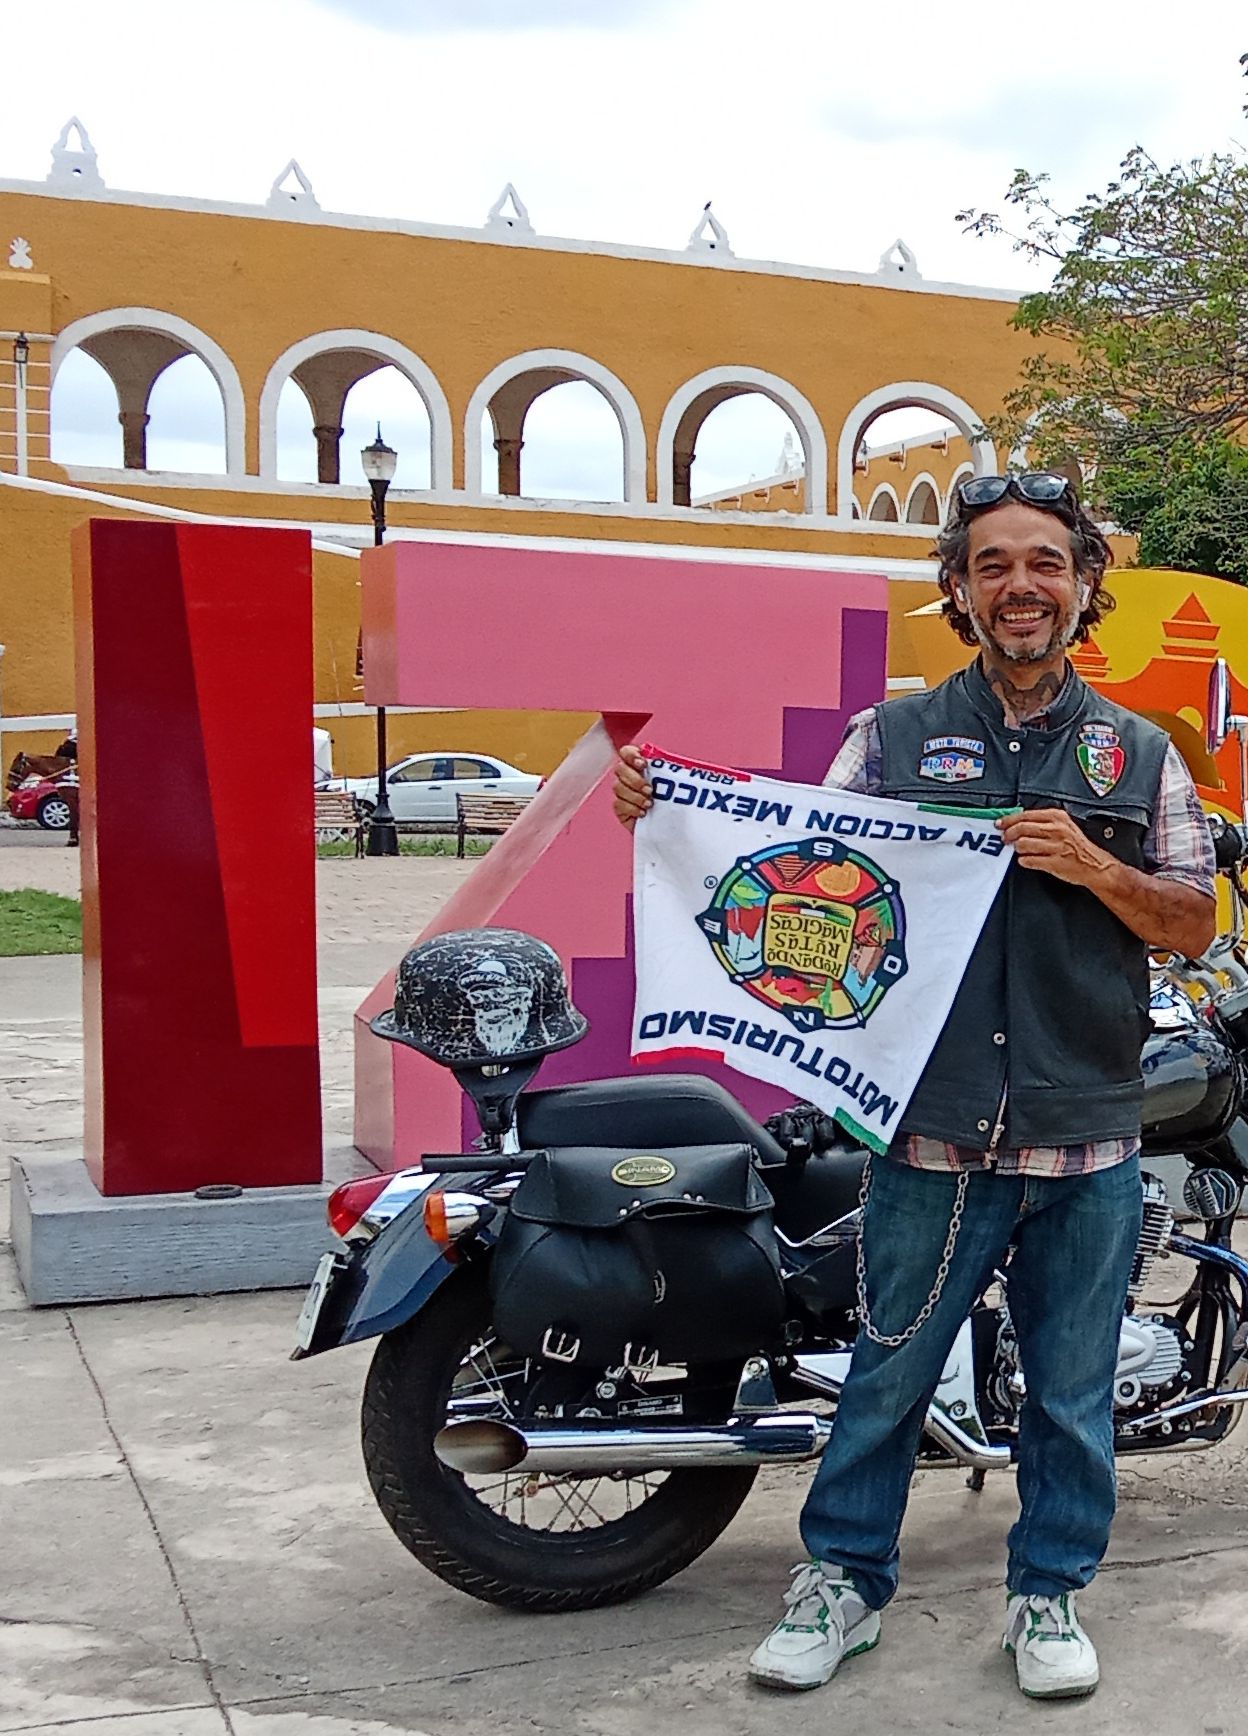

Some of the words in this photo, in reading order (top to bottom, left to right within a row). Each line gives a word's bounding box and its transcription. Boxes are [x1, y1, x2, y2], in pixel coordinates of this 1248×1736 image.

[690, 768, 735, 786] RRM
[651, 776, 792, 824] MÉXICO
[813, 841, 834, 857] S
[958, 826, 1005, 857] EN
[704, 918, 721, 935] E
[883, 954, 901, 975] O
[793, 1010, 815, 1026] N
[640, 1012, 899, 1127] MOTOTURISMO
